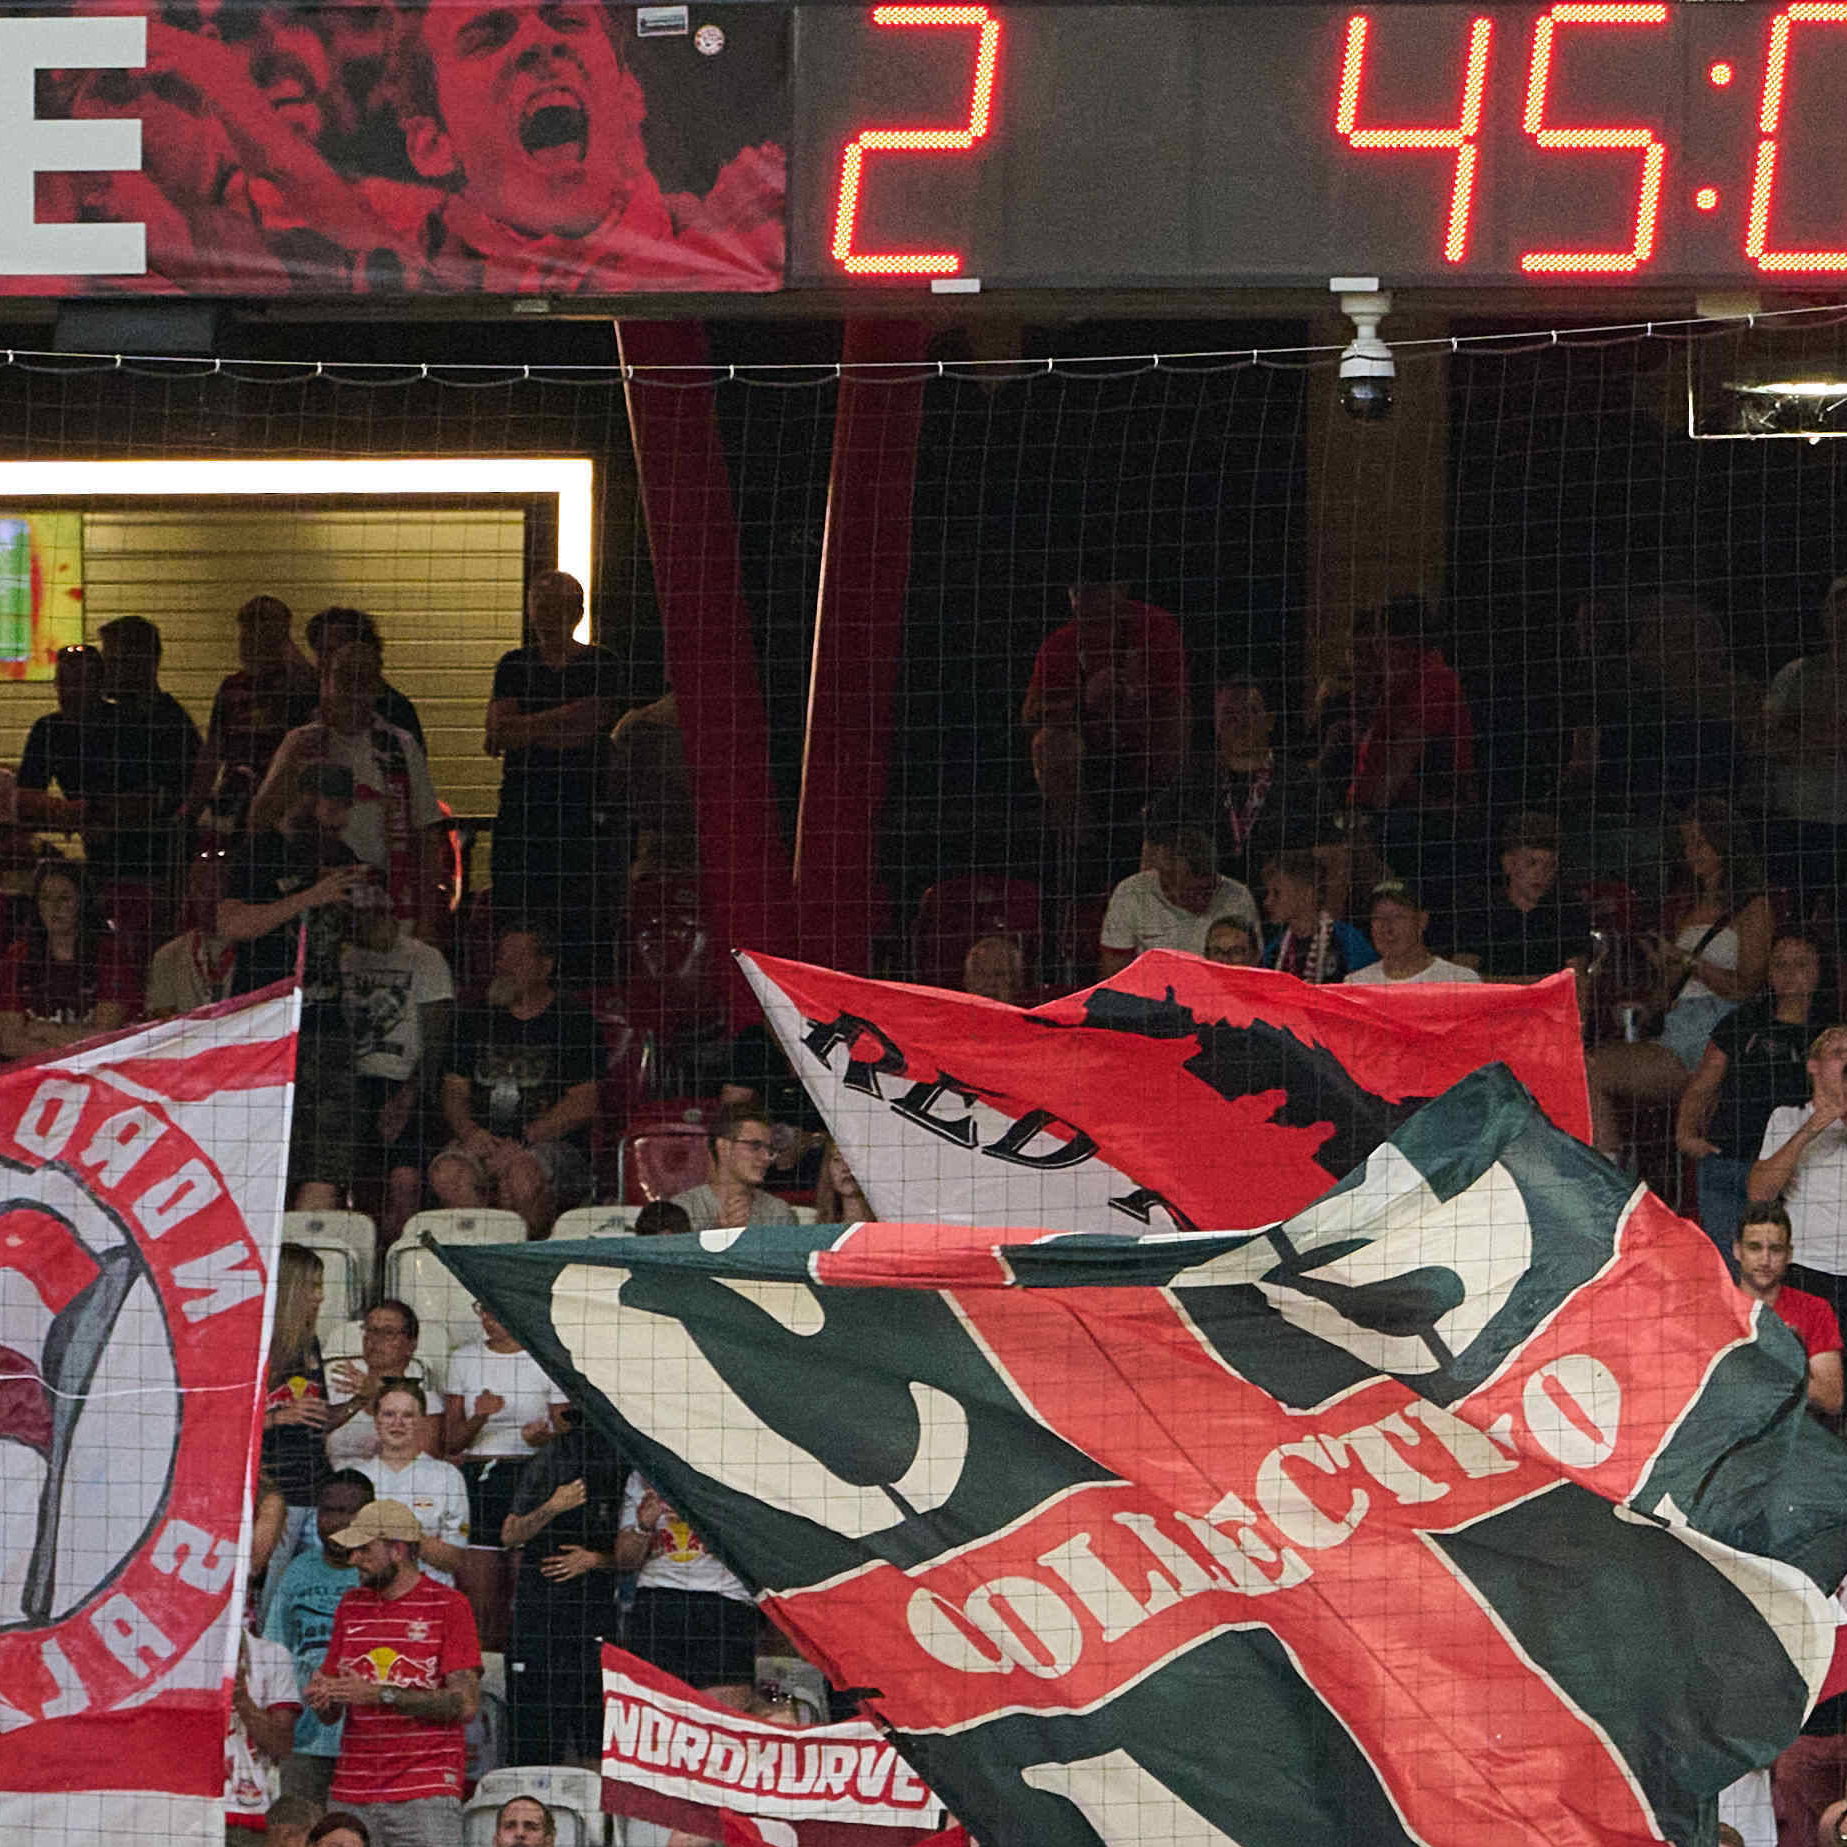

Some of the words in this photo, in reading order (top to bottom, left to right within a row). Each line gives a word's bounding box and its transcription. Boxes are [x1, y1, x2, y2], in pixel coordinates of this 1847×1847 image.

[835, 4, 997, 274] 2
[800, 1014, 1101, 1172] RED
[603, 1696, 931, 1806] NORDKURVE
